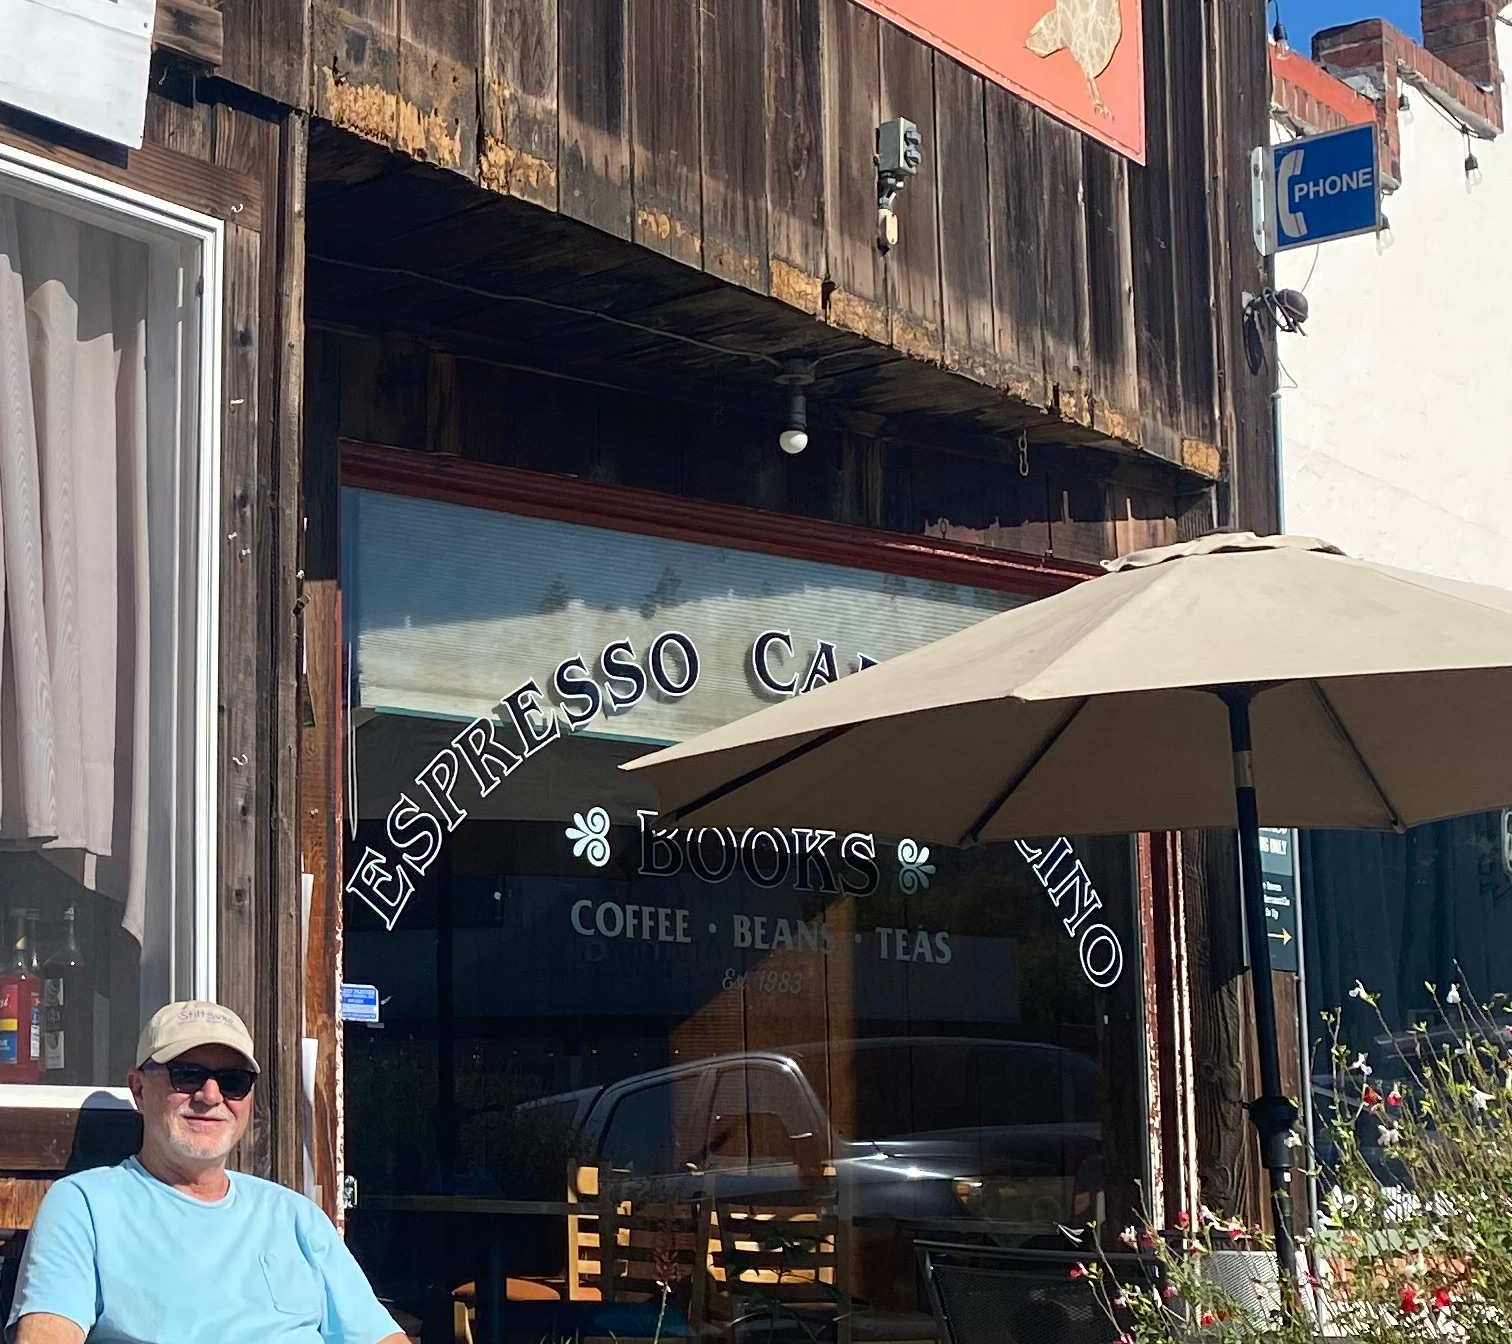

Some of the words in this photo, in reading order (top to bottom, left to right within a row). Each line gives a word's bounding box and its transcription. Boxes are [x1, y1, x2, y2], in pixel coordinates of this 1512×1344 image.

[1294, 167, 1373, 202] PHONE
[346, 631, 700, 931] ESPRESSO
[636, 809, 880, 898] BOOKS
[571, 899, 692, 943] COFFEE
[733, 914, 831, 953] BEANS
[875, 925, 952, 963] TEAS
